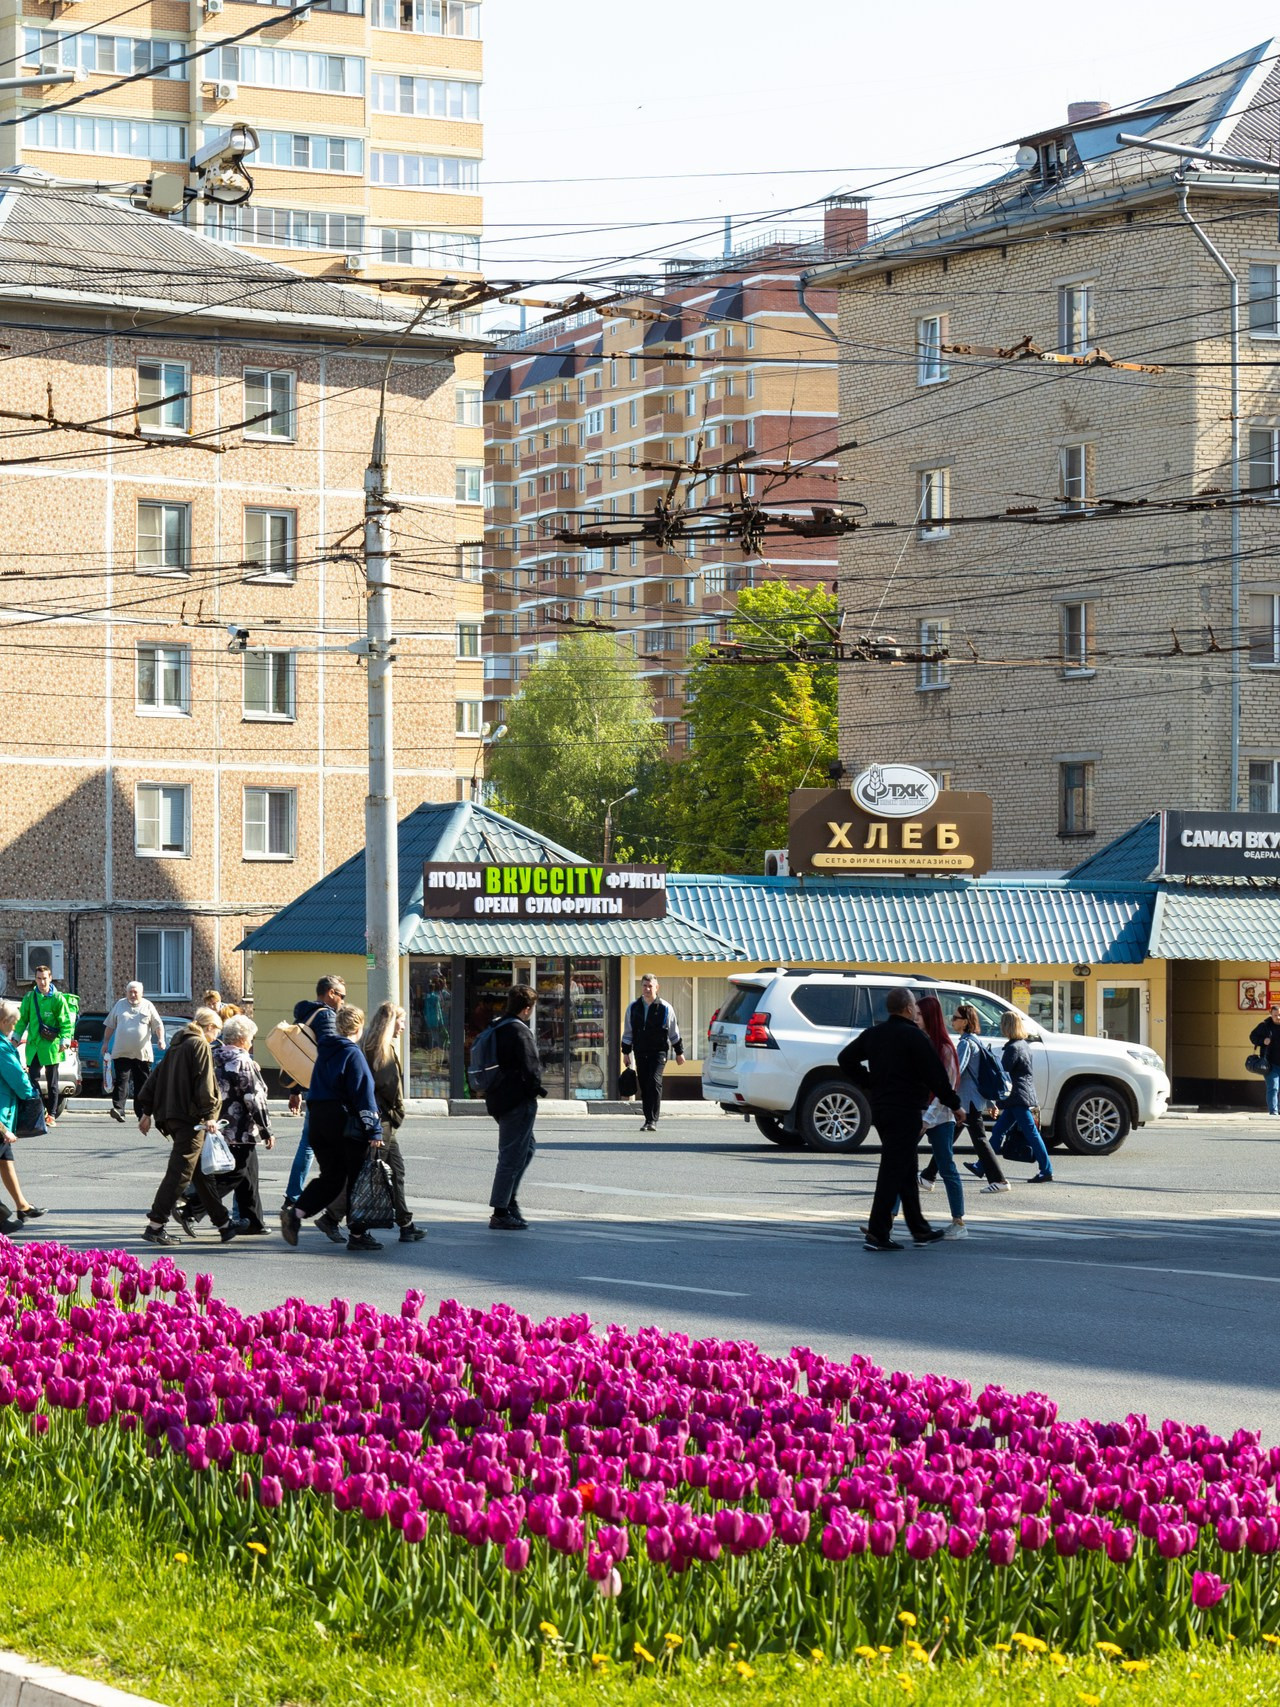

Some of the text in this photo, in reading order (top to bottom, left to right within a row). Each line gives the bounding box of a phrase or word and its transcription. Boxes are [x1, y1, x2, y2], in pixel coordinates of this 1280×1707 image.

[888, 784, 929, 798] ТХК
[827, 821, 960, 850] ХЛЕБ
[1181, 829, 1280, 848] САМАЯ ВКУ
[428, 871, 481, 890] ЯГОДЫ
[606, 872, 665, 890] ФРУКТЫ
[474, 896, 622, 914] ОРЕХИ СУХОФРУКТЫ
